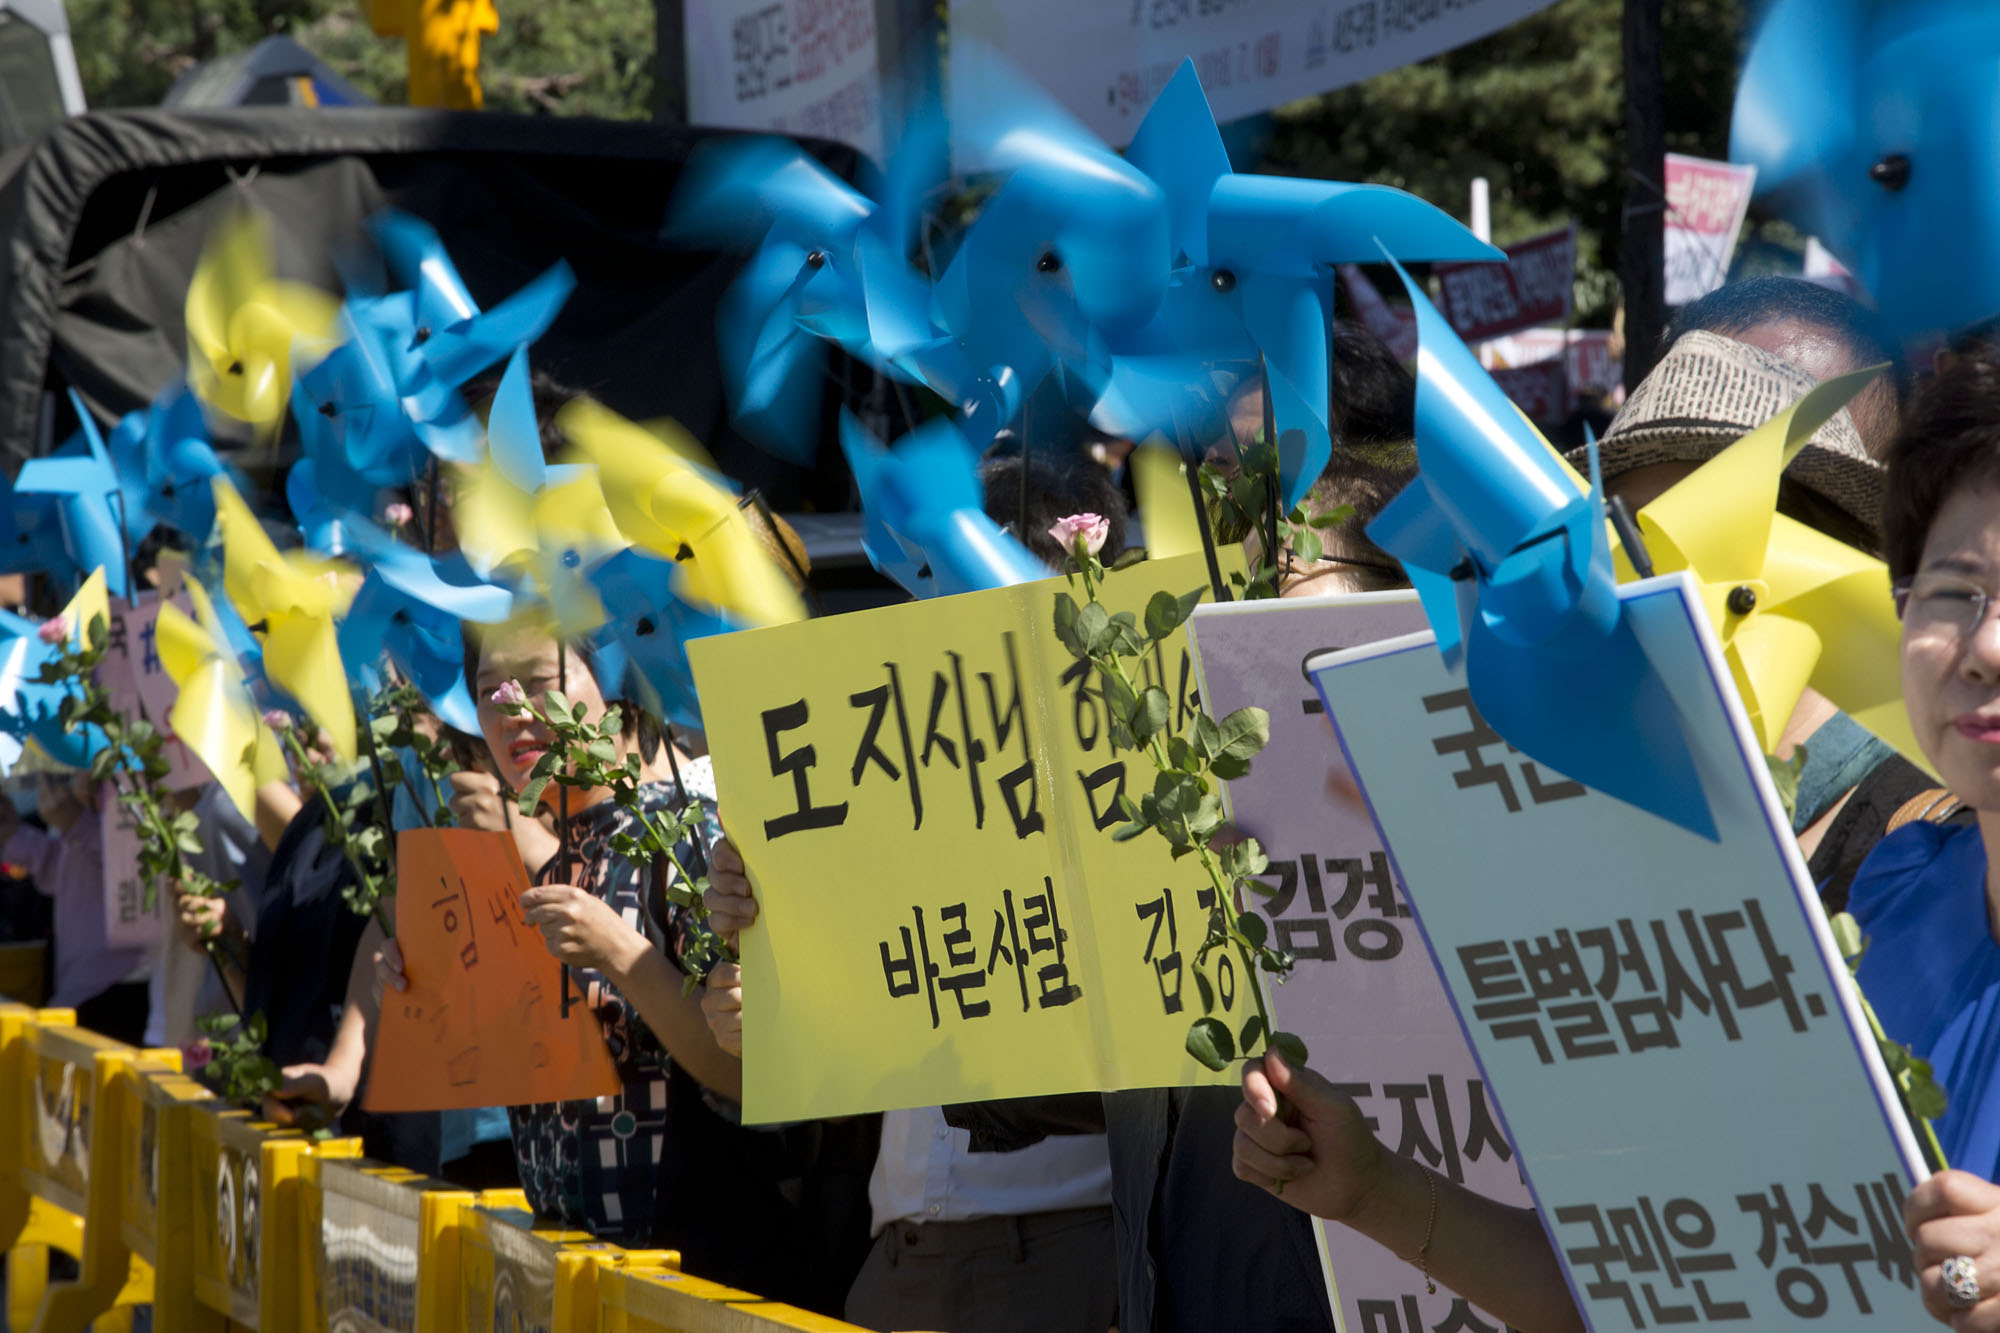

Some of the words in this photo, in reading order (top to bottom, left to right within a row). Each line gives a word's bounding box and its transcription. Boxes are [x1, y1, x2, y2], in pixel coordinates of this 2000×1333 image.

[761, 631, 1045, 841] 도지사님
[879, 876, 1083, 1029] 바른사람
[1259, 851, 1412, 962] 김경
[1456, 899, 1828, 1064] 특별검사다.
[1554, 1196, 1752, 1330] 국민은
